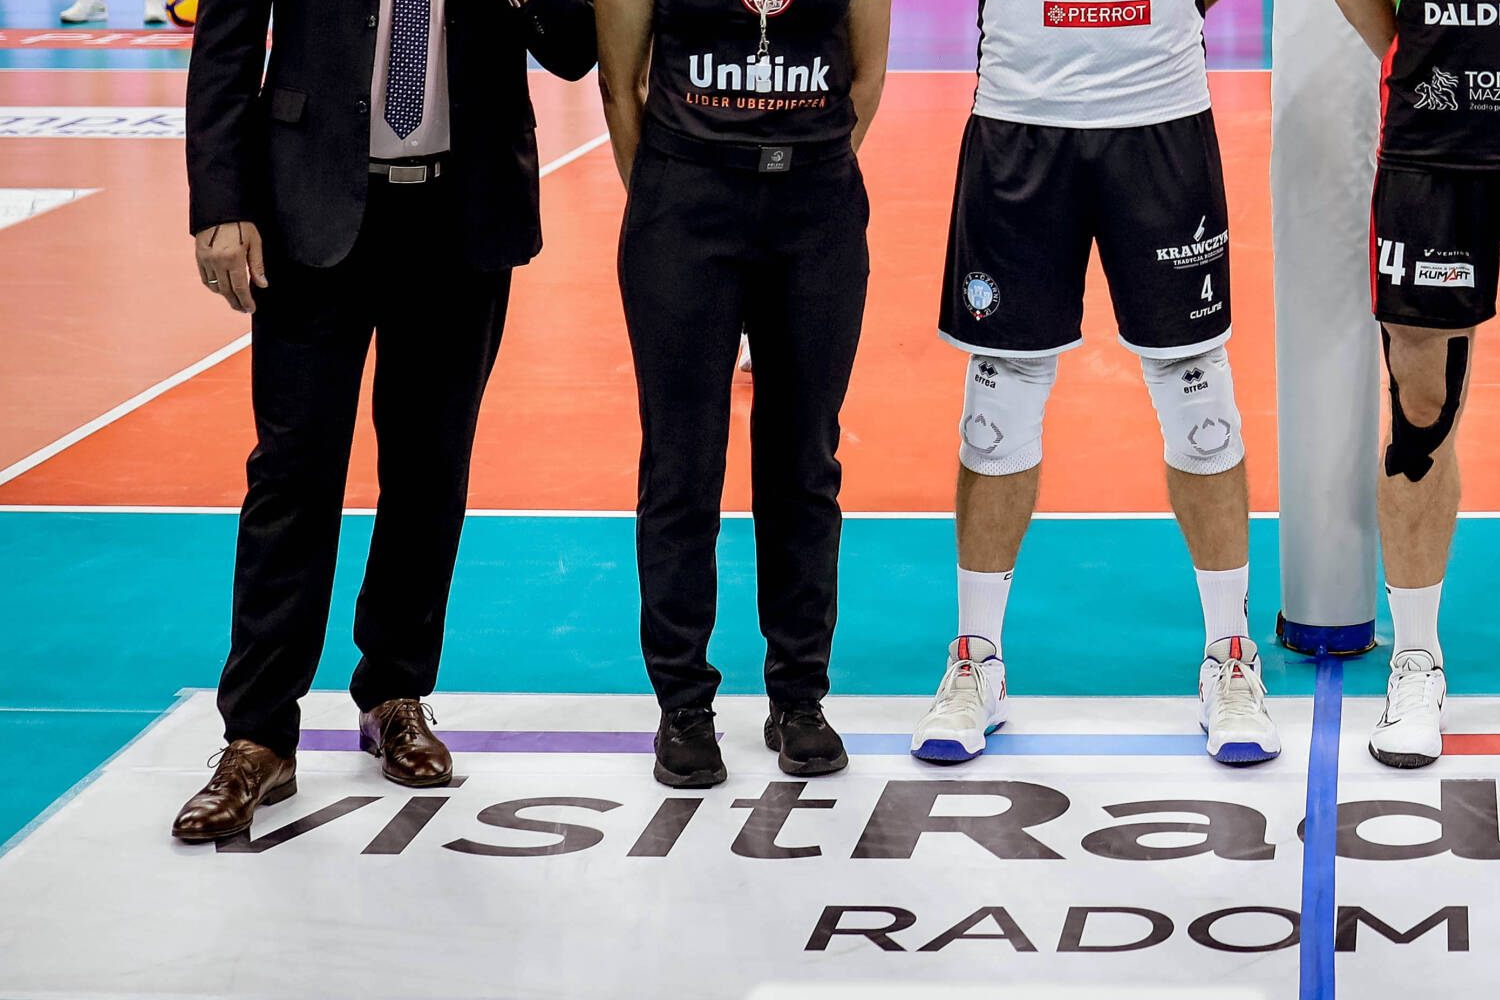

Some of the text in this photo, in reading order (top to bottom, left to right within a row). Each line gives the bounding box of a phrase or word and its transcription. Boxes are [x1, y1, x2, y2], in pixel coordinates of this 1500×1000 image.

[1068, 5, 1147, 23] PIERROT
[689, 53, 831, 93] Uniink
[686, 92, 730, 107] LIDER
[1156, 229, 1229, 261] KRAWCZYK
[1378, 237, 1405, 286] 4
[1201, 273, 1214, 302] 4
[1189, 300, 1223, 320] CUTLINE
[804, 904, 1471, 954] RADOM
